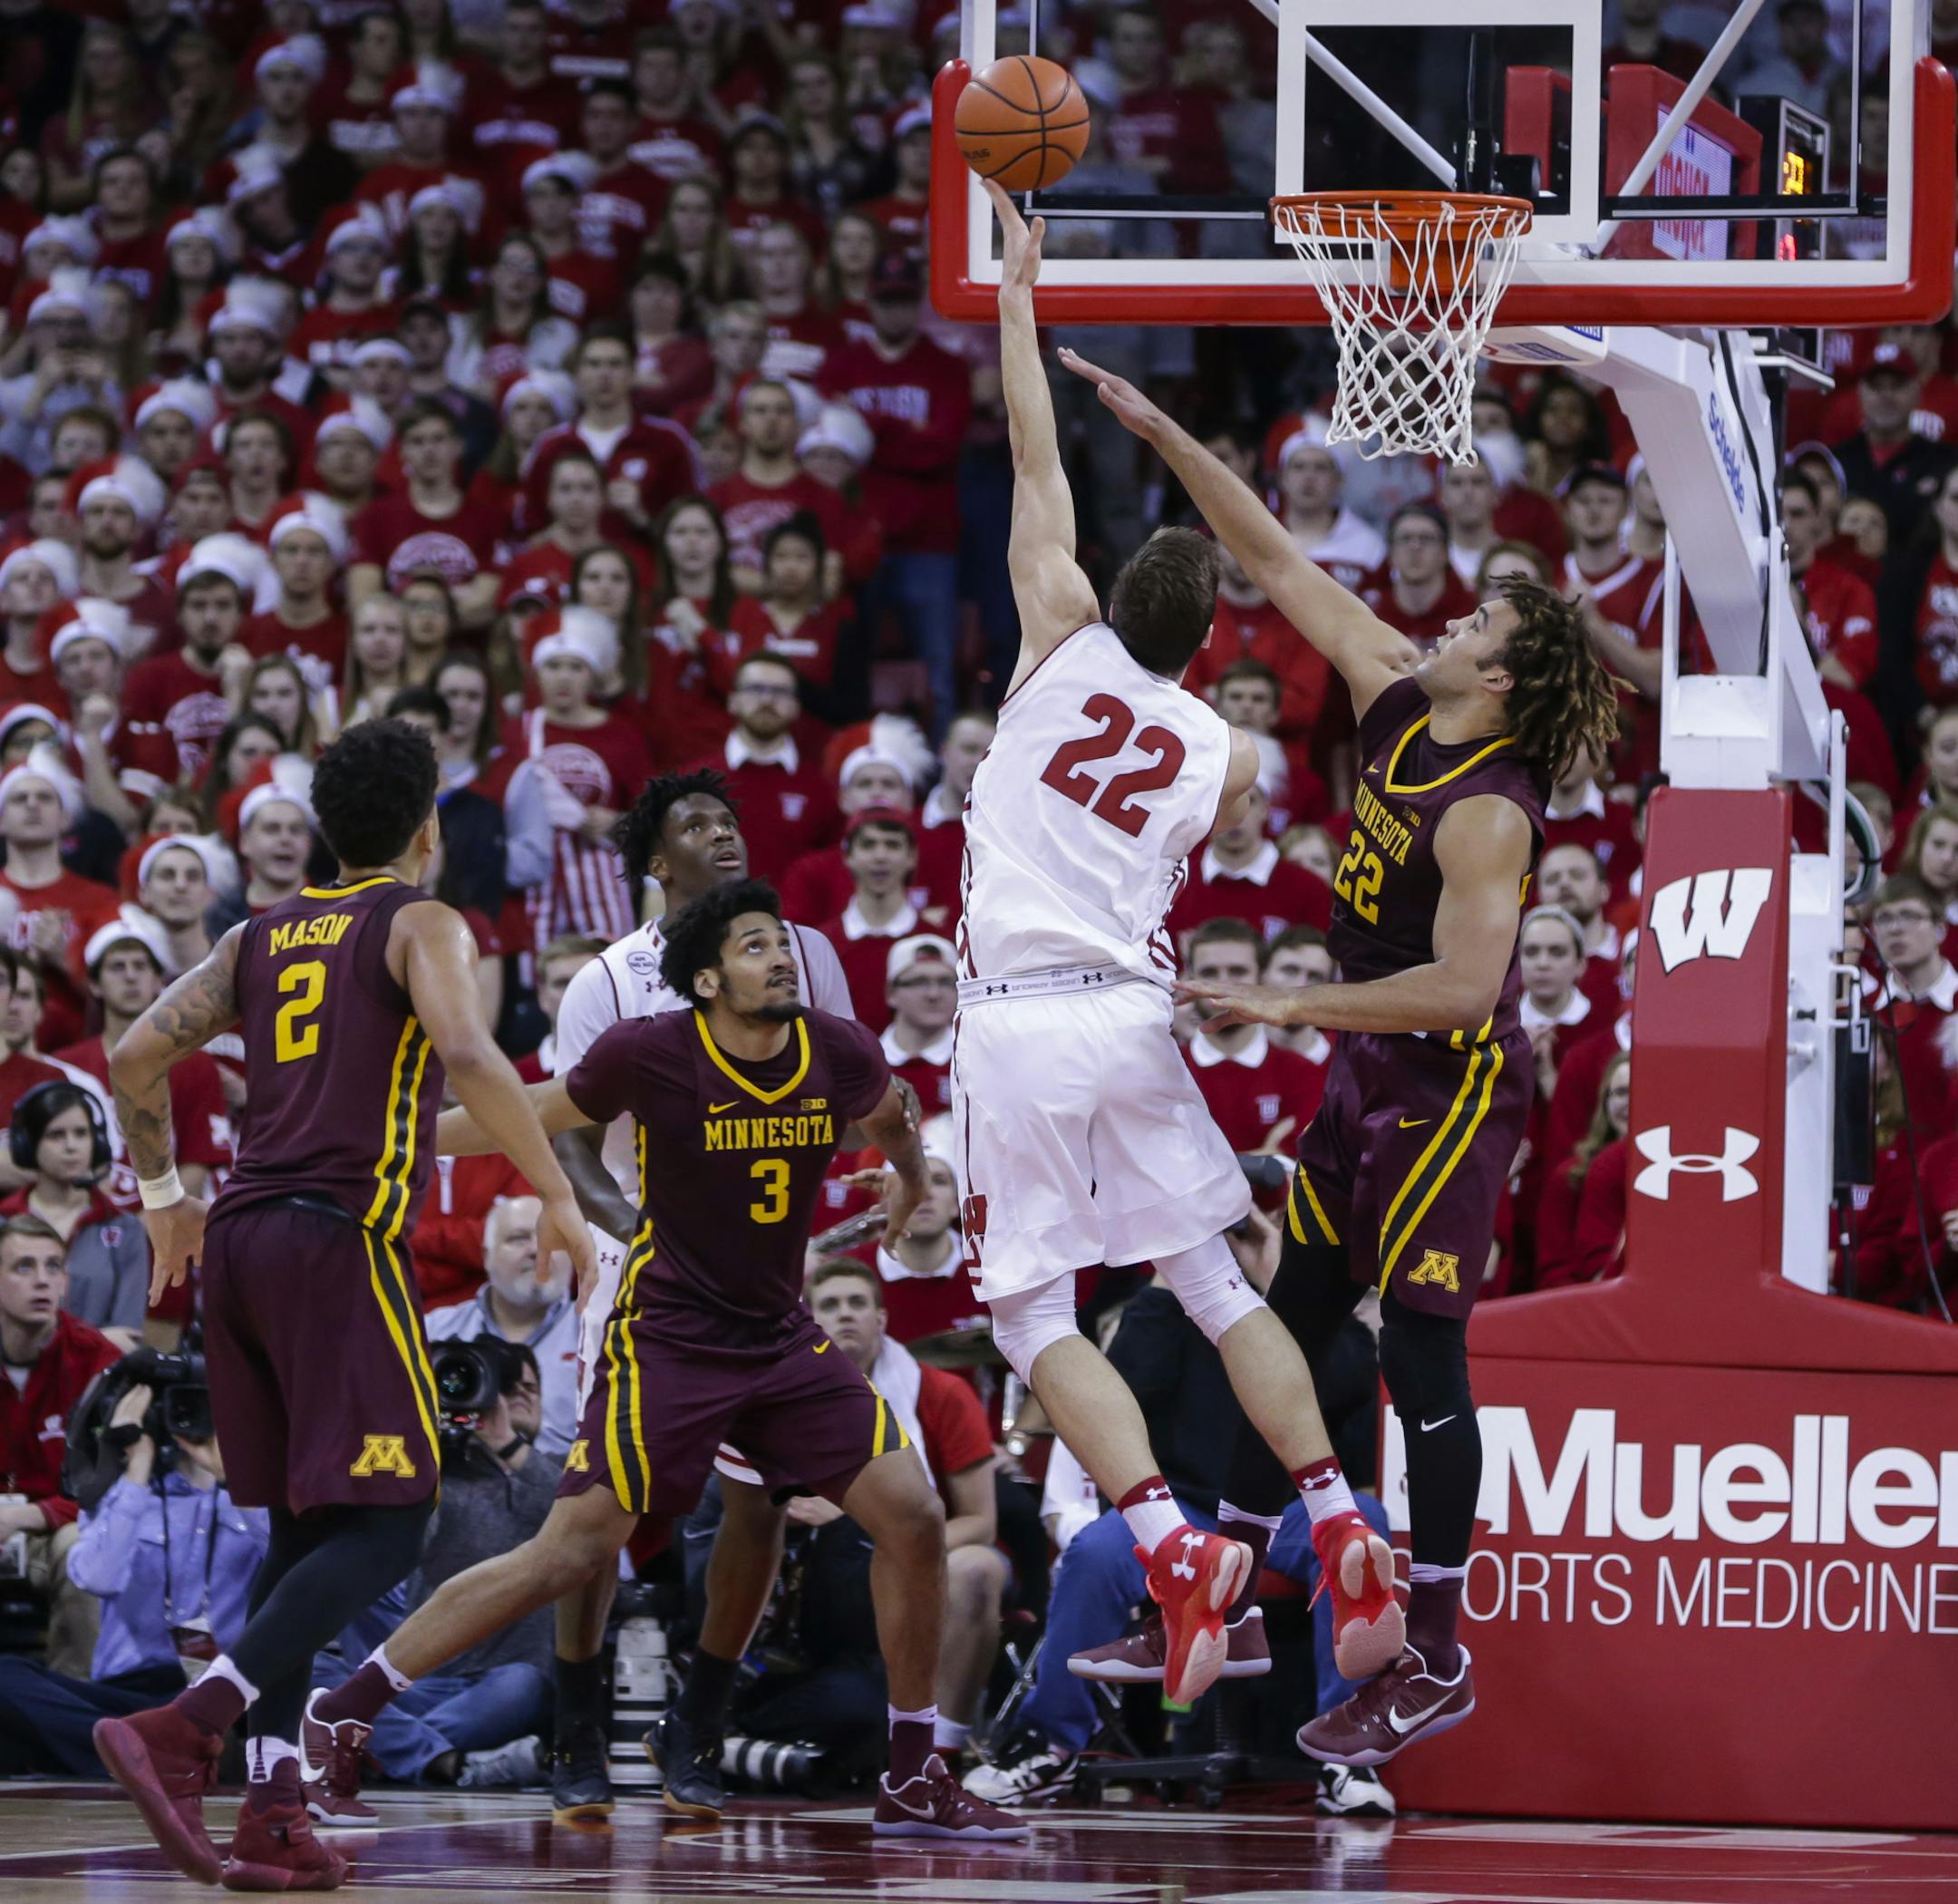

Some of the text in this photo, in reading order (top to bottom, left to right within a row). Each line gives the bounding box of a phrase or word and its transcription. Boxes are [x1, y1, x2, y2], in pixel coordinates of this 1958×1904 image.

[1040, 693, 1187, 839] 22
[1354, 777, 1413, 866] MINNESOTA
[1333, 830, 1384, 925] 22
[269, 914, 354, 957] MASON
[1648, 868, 1773, 976] W
[275, 960, 327, 1064] 2
[703, 1114, 834, 1151] MINNESOTA
[750, 1158, 790, 1224] 3
[1407, 1248, 1460, 1293] M
[350, 1434, 416, 1478] M
[1393, 1549, 1958, 1633] ORTS MEDICINE
